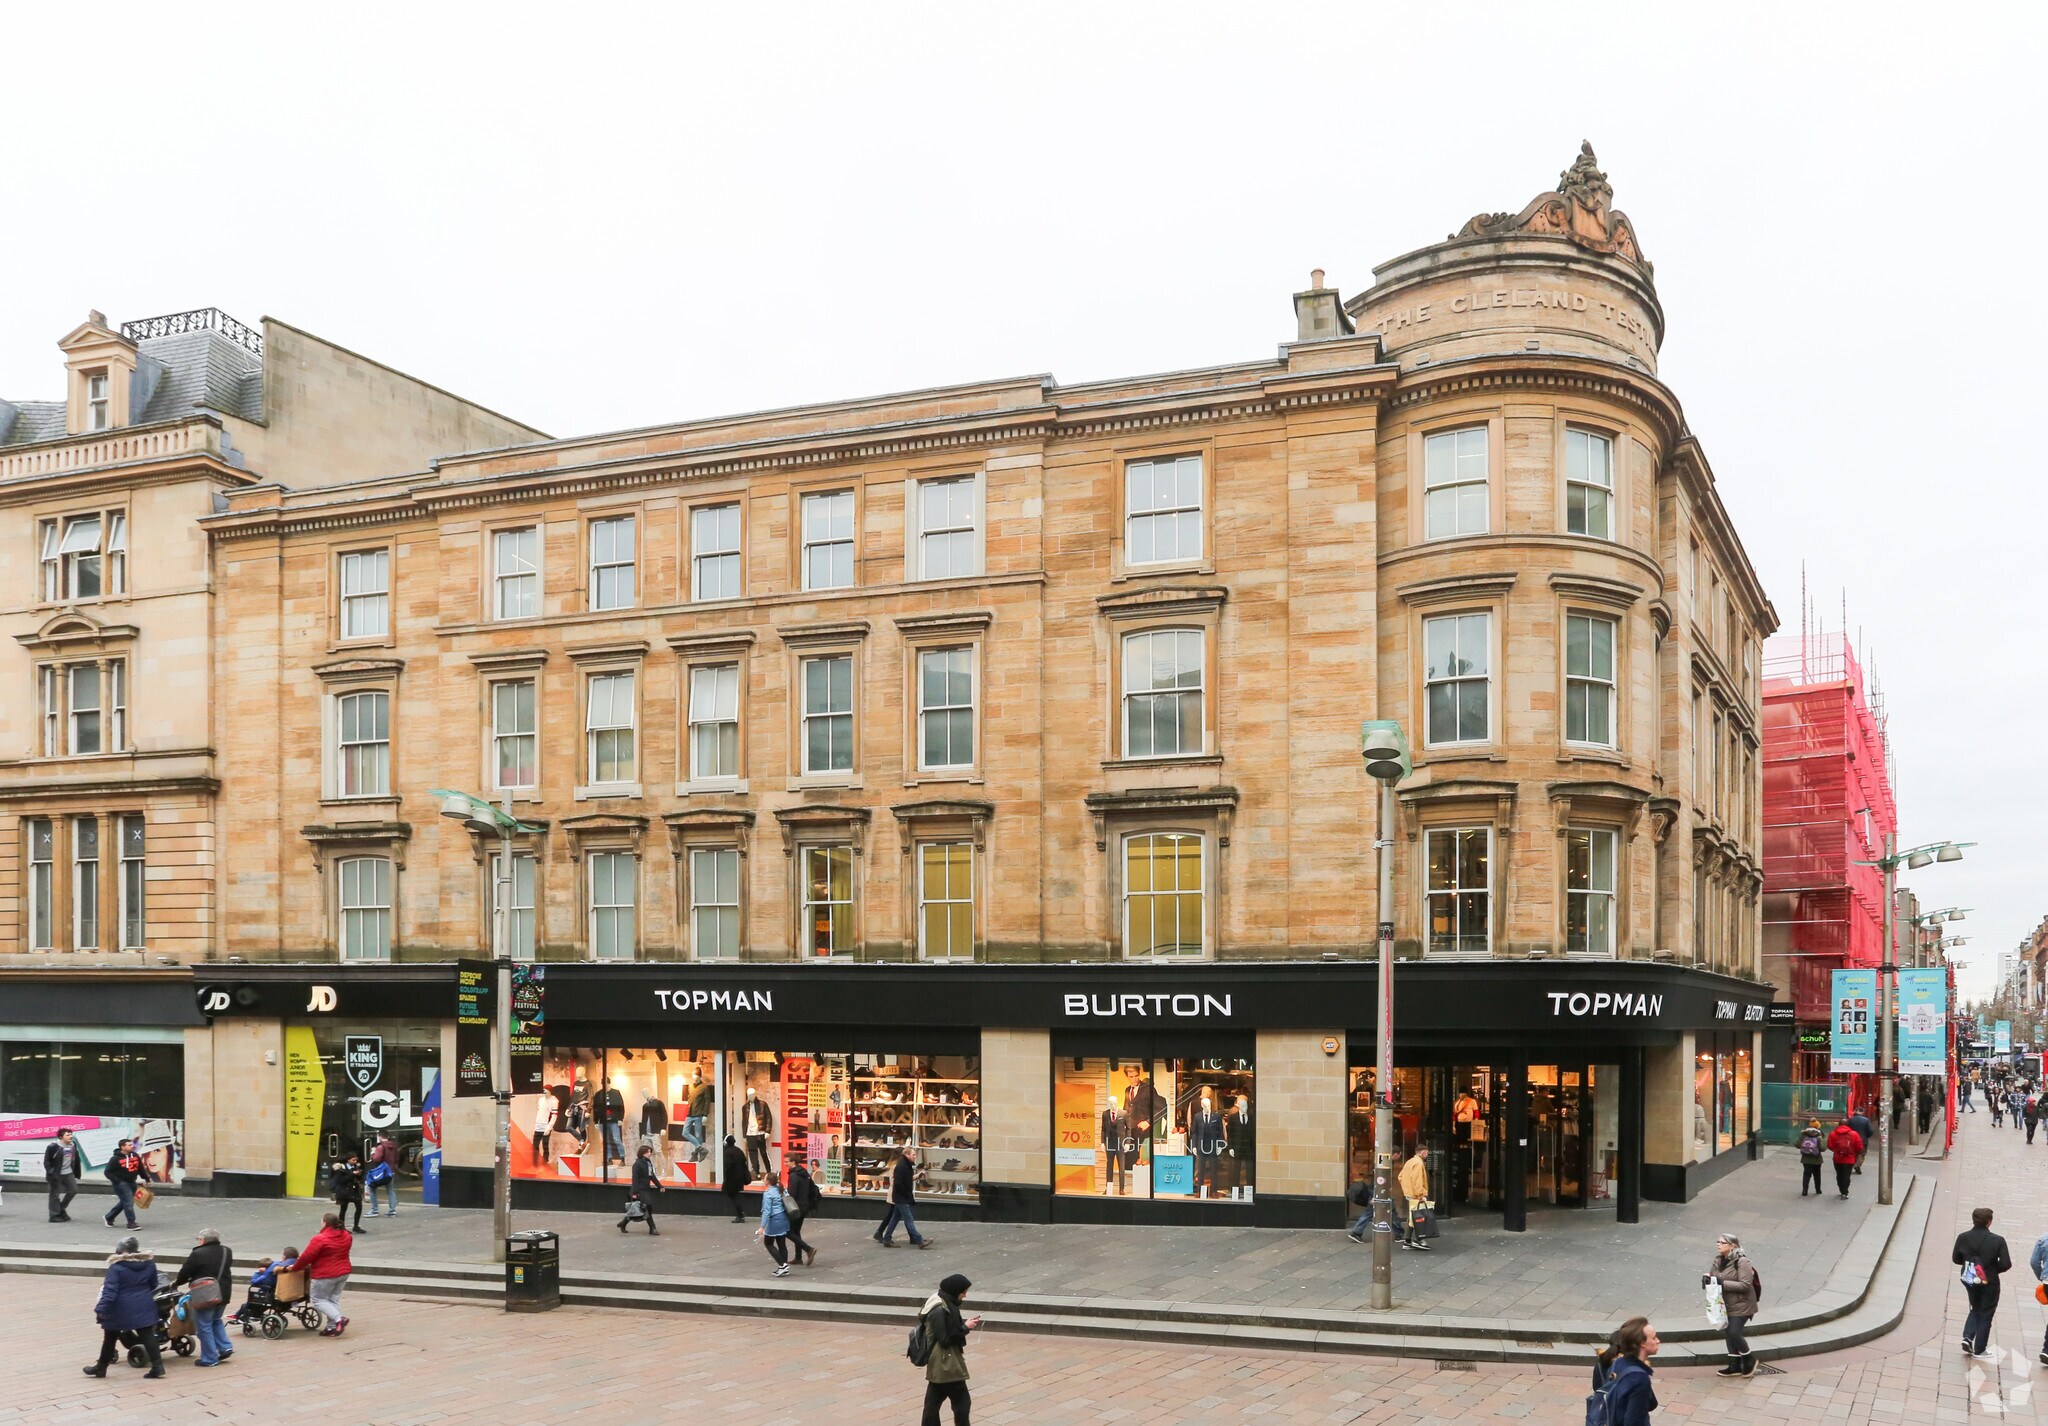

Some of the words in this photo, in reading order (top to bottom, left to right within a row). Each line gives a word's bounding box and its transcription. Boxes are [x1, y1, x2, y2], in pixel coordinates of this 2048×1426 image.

[1378, 302, 1431, 335] THE
[1451, 289, 1588, 314] CLELAND
[1600, 301, 1656, 356] TESTI
[204, 992, 231, 1011] JD
[306, 986, 337, 1012] JD
[514, 1002, 539, 1010] FESTIVAL
[654, 990, 773, 1011] TOPMAN
[1064, 994, 1232, 1017] BURTON
[1547, 992, 1663, 1017] TOPMAN
[1715, 1000, 1738, 1020] TOPMAN
[1744, 1004, 1766, 1021] BURTON
[350, 1052, 378, 1063] KING
[831, 1060, 843, 1081] NEW
[788, 1061, 810, 1119] RULES
[361, 1090, 422, 1128] GL
[1064, 1112, 1087, 1120] SALE
[1201, 1139, 1228, 1155] UP
[1164, 1174, 1181, 1183] £79
